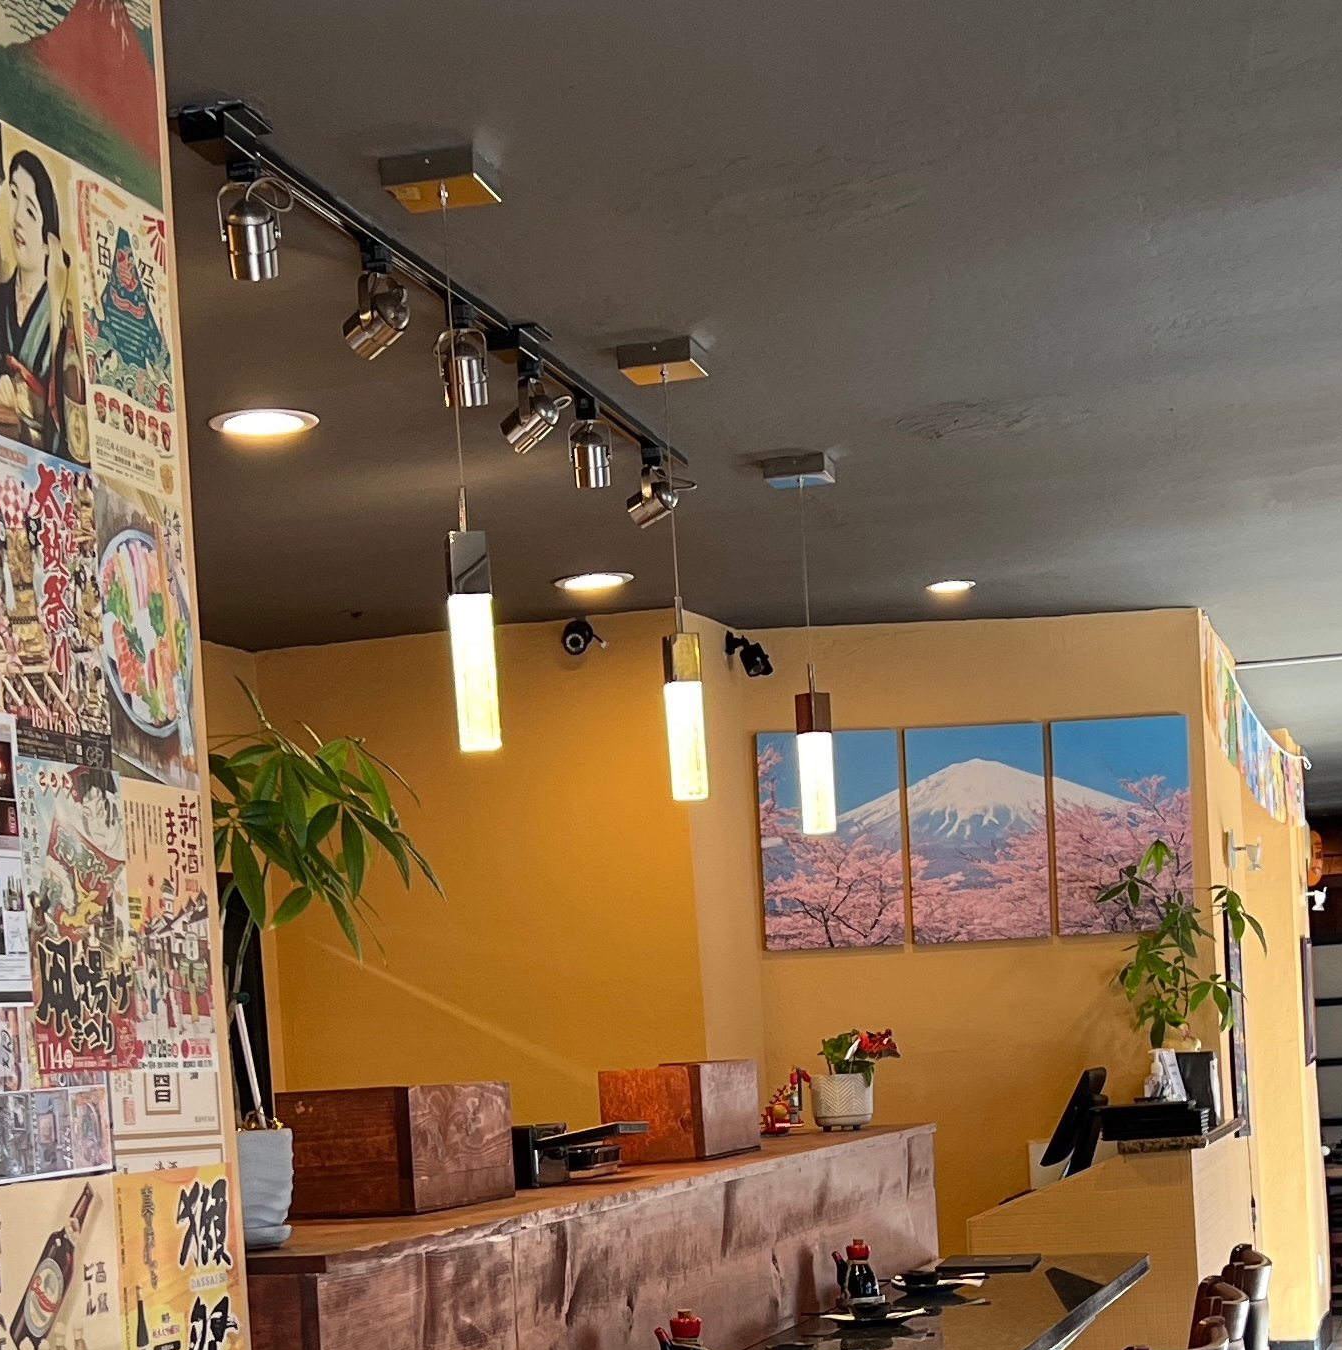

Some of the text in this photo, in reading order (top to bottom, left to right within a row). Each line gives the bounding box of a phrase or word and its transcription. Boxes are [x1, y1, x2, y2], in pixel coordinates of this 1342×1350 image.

[164, 808, 179, 898] まつり
[177, 794, 199, 874] 新酒
[82, 1260, 98, 1317] ビール
